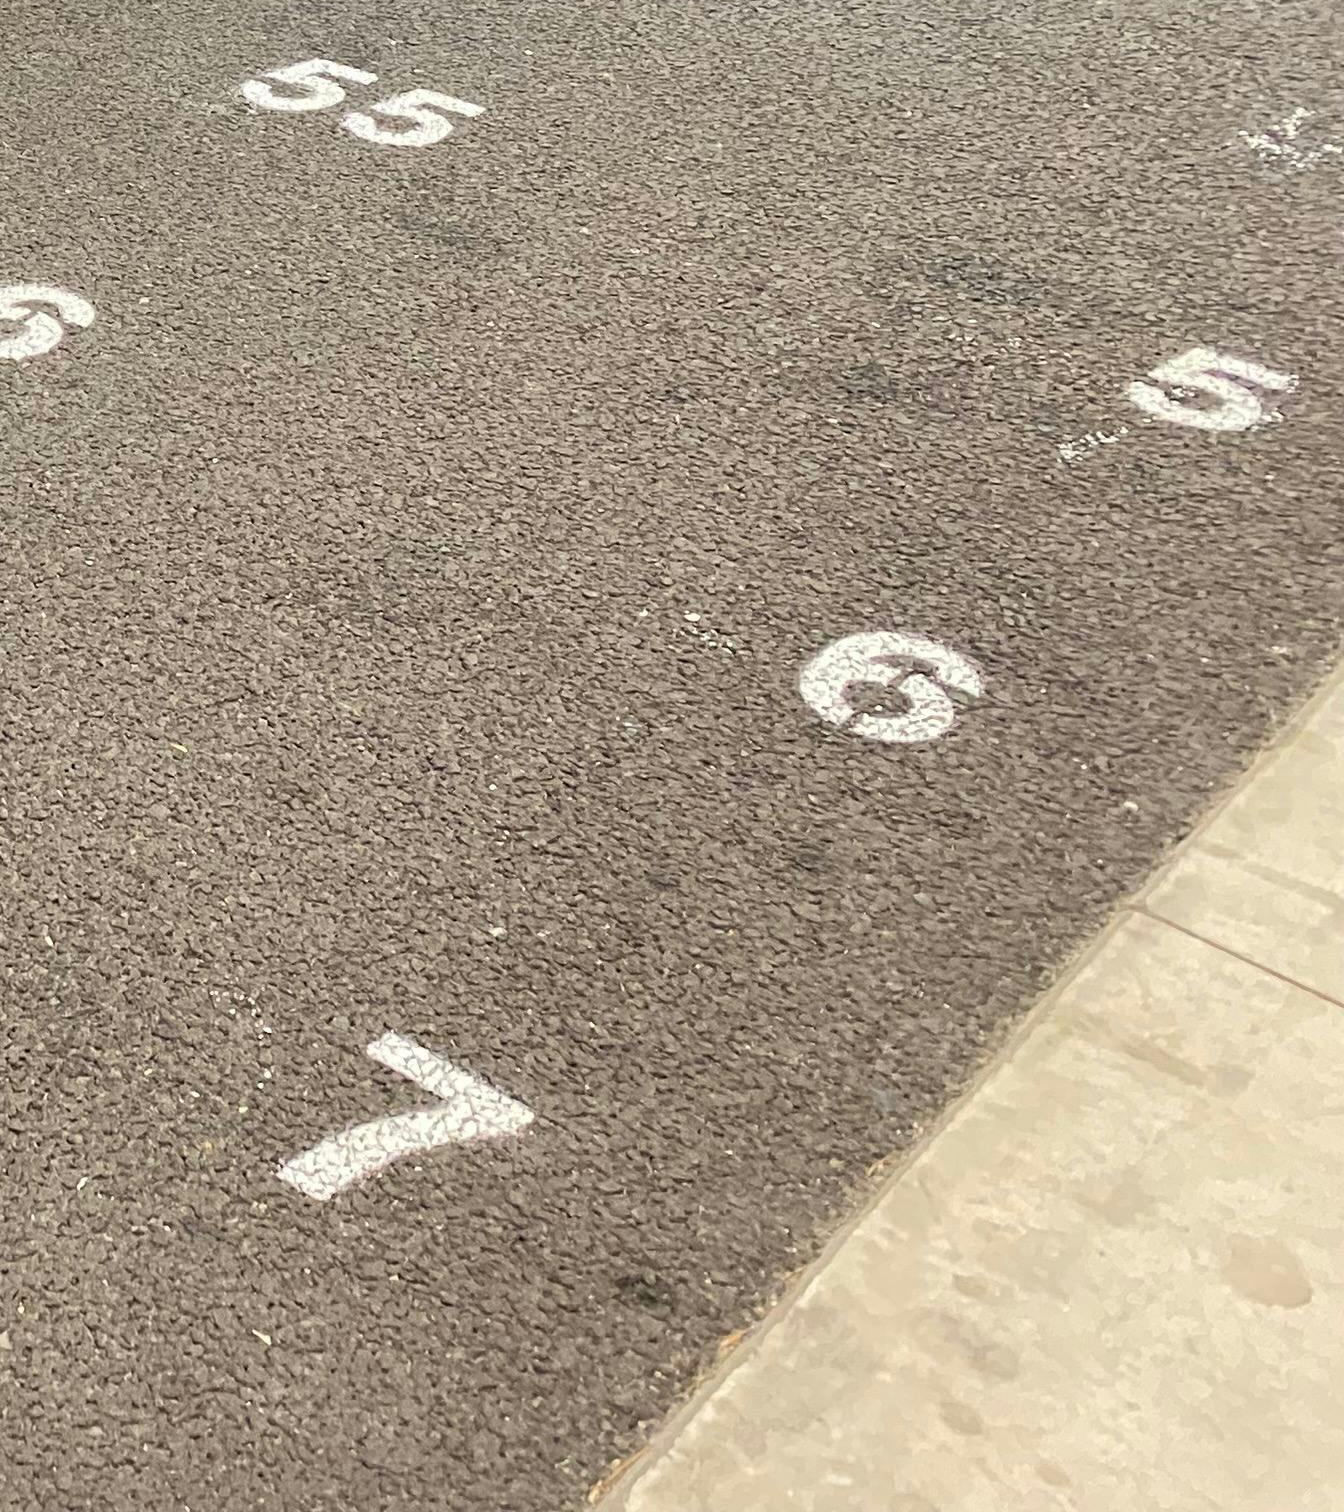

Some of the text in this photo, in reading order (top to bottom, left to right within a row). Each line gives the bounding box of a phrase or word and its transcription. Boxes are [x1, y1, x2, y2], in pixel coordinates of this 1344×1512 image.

[241, 58, 485, 147] 55
[1129, 348, 1298, 431] 5
[799, 631, 983, 742] 6
[276, 1032, 535, 1200] 7
